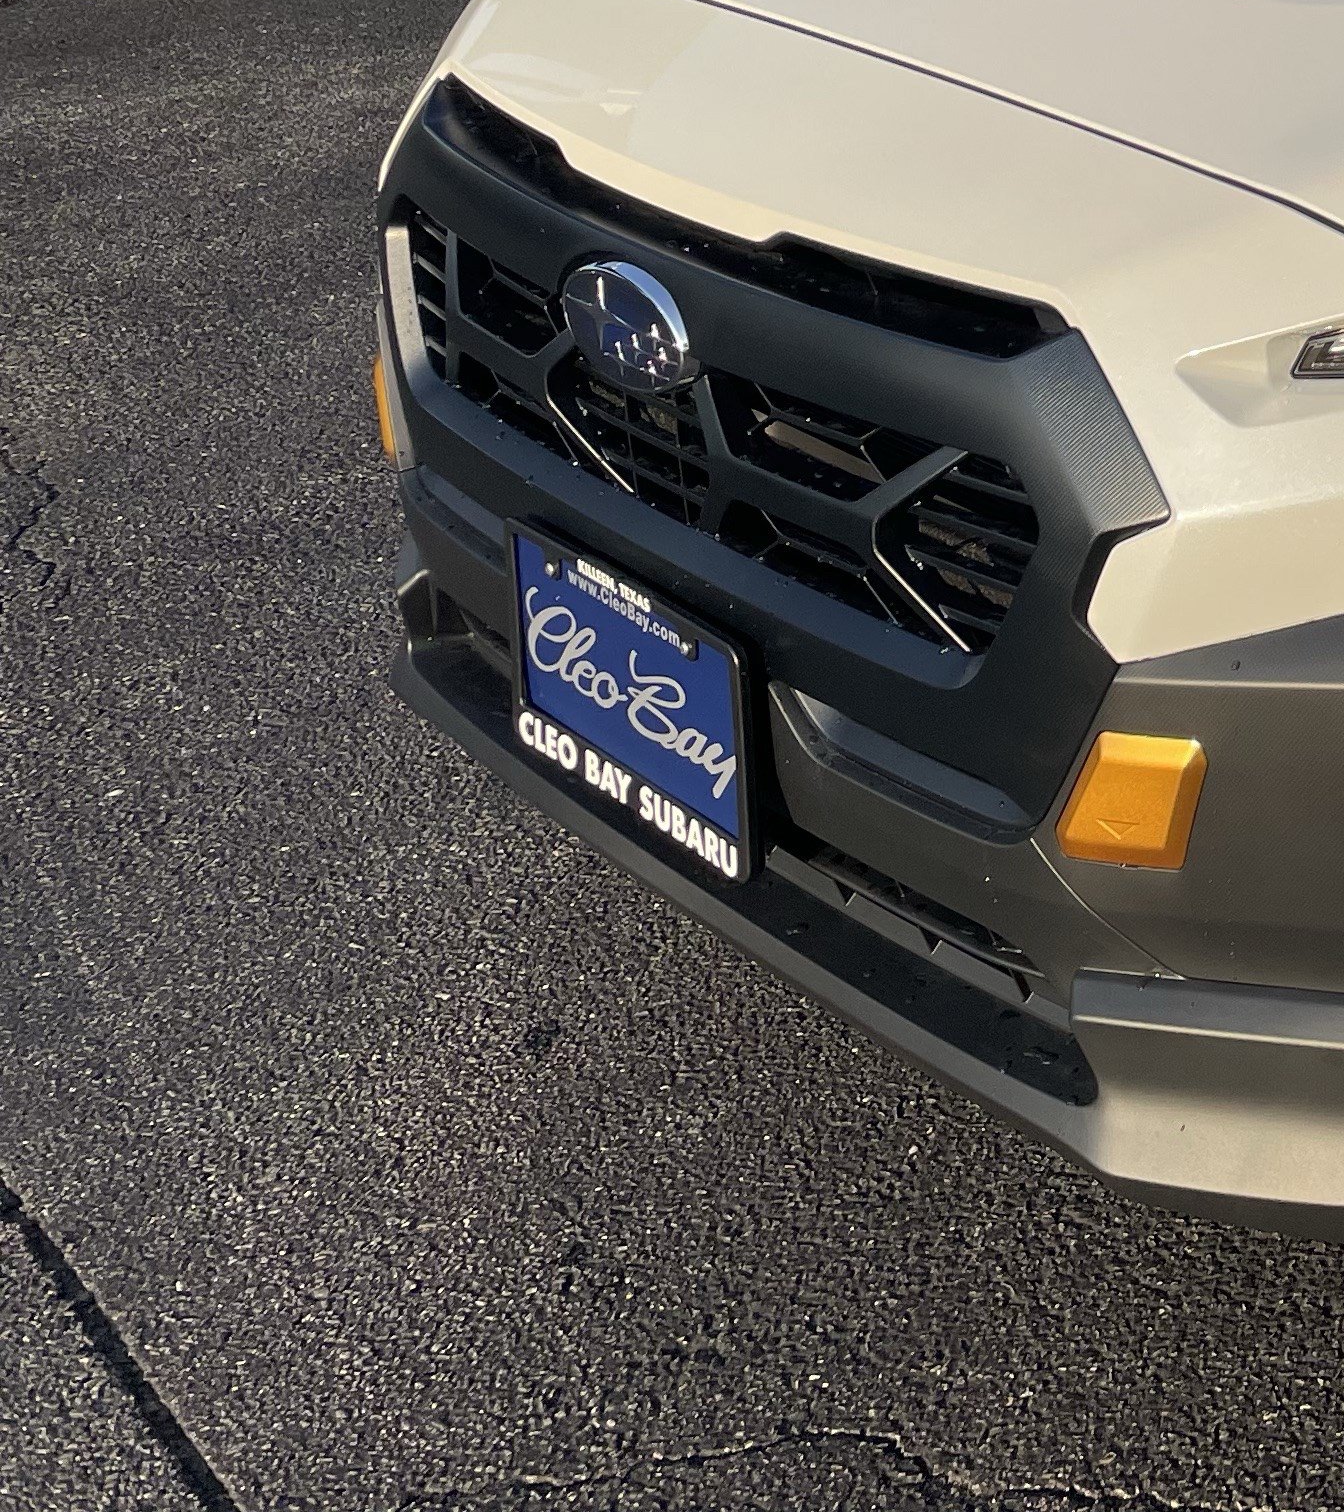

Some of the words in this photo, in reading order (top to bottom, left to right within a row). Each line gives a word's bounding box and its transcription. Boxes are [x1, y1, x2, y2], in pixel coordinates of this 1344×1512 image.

[567, 569, 681, 647] www.CleoBay.com
[576, 558, 618, 593] KILLEEN,
[618, 582, 652, 613] TEXAS
[525, 586, 627, 709] Cleo
[626, 649, 737, 799] Bay
[518, 711, 579, 771] CLEO
[584, 750, 632, 805] BAY
[638, 785, 738, 879] SUBARU
